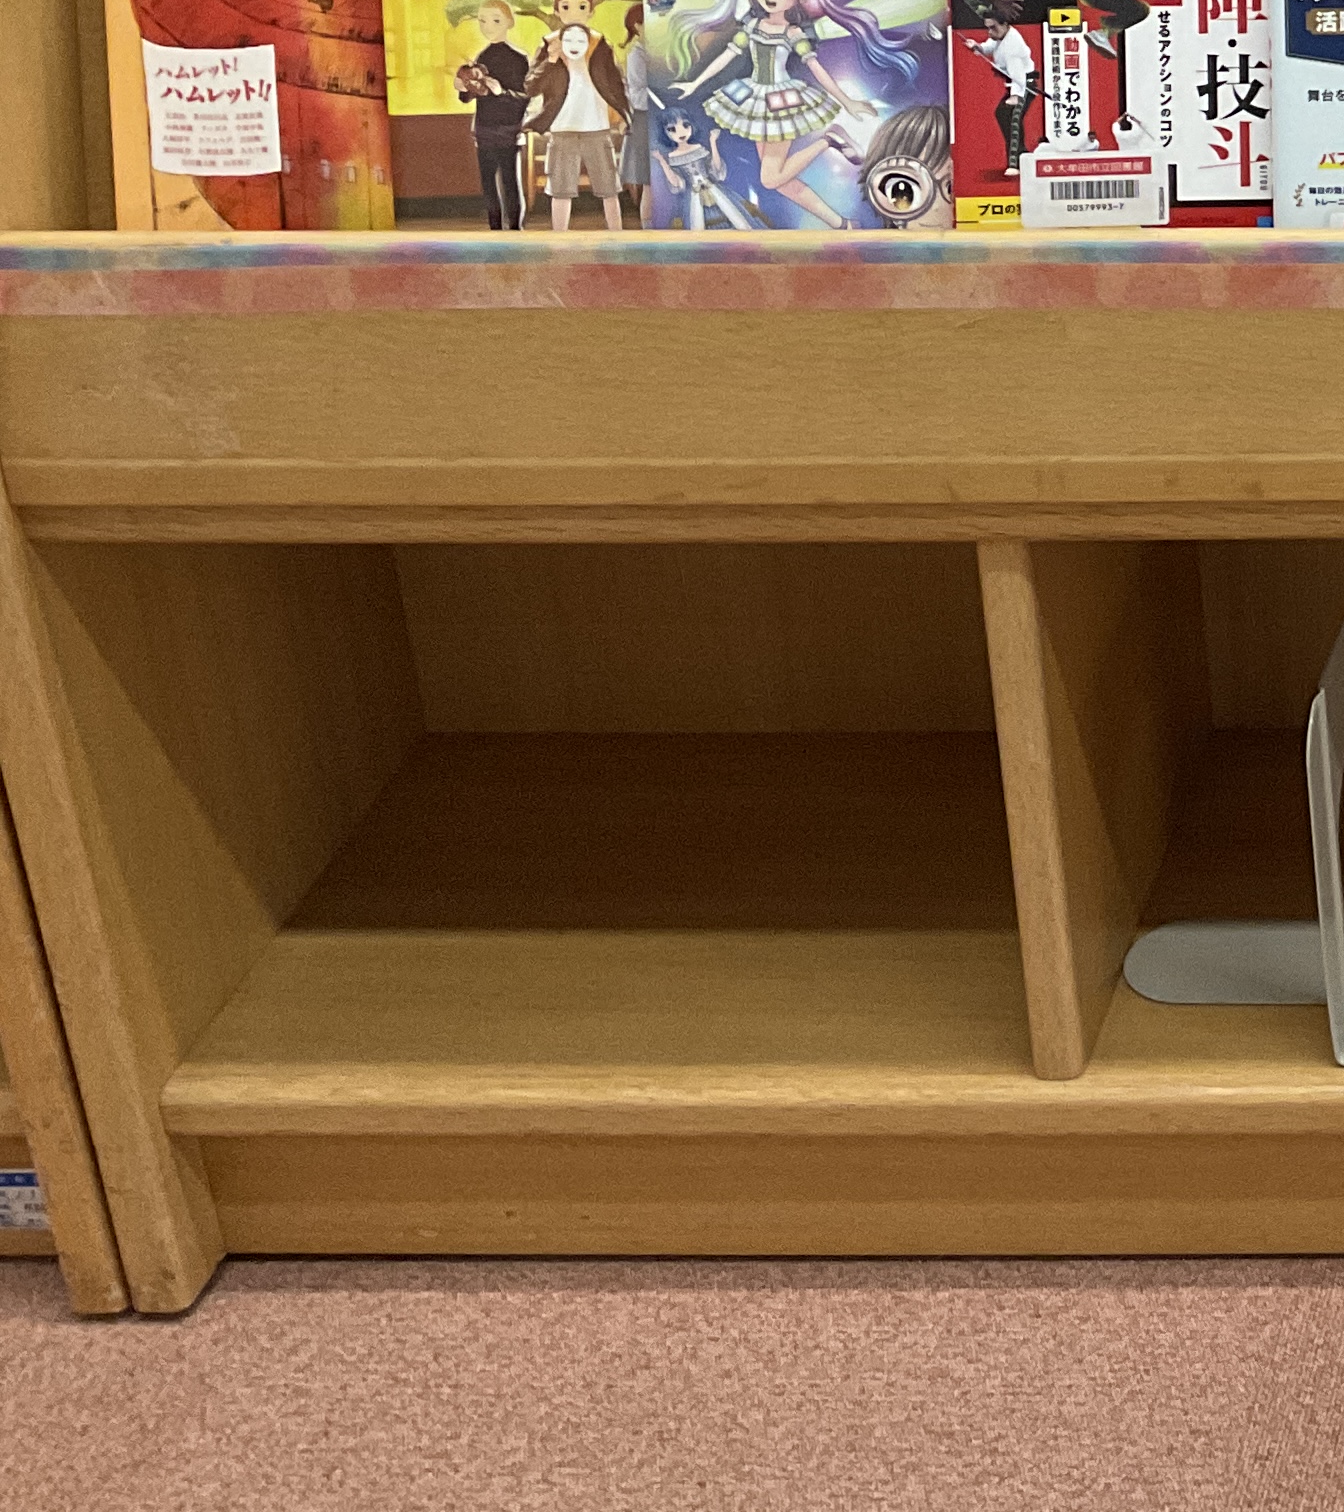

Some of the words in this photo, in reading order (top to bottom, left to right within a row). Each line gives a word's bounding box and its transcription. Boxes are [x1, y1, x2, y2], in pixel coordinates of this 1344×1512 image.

[1064, 37, 1082, 137] 動画でわかる
